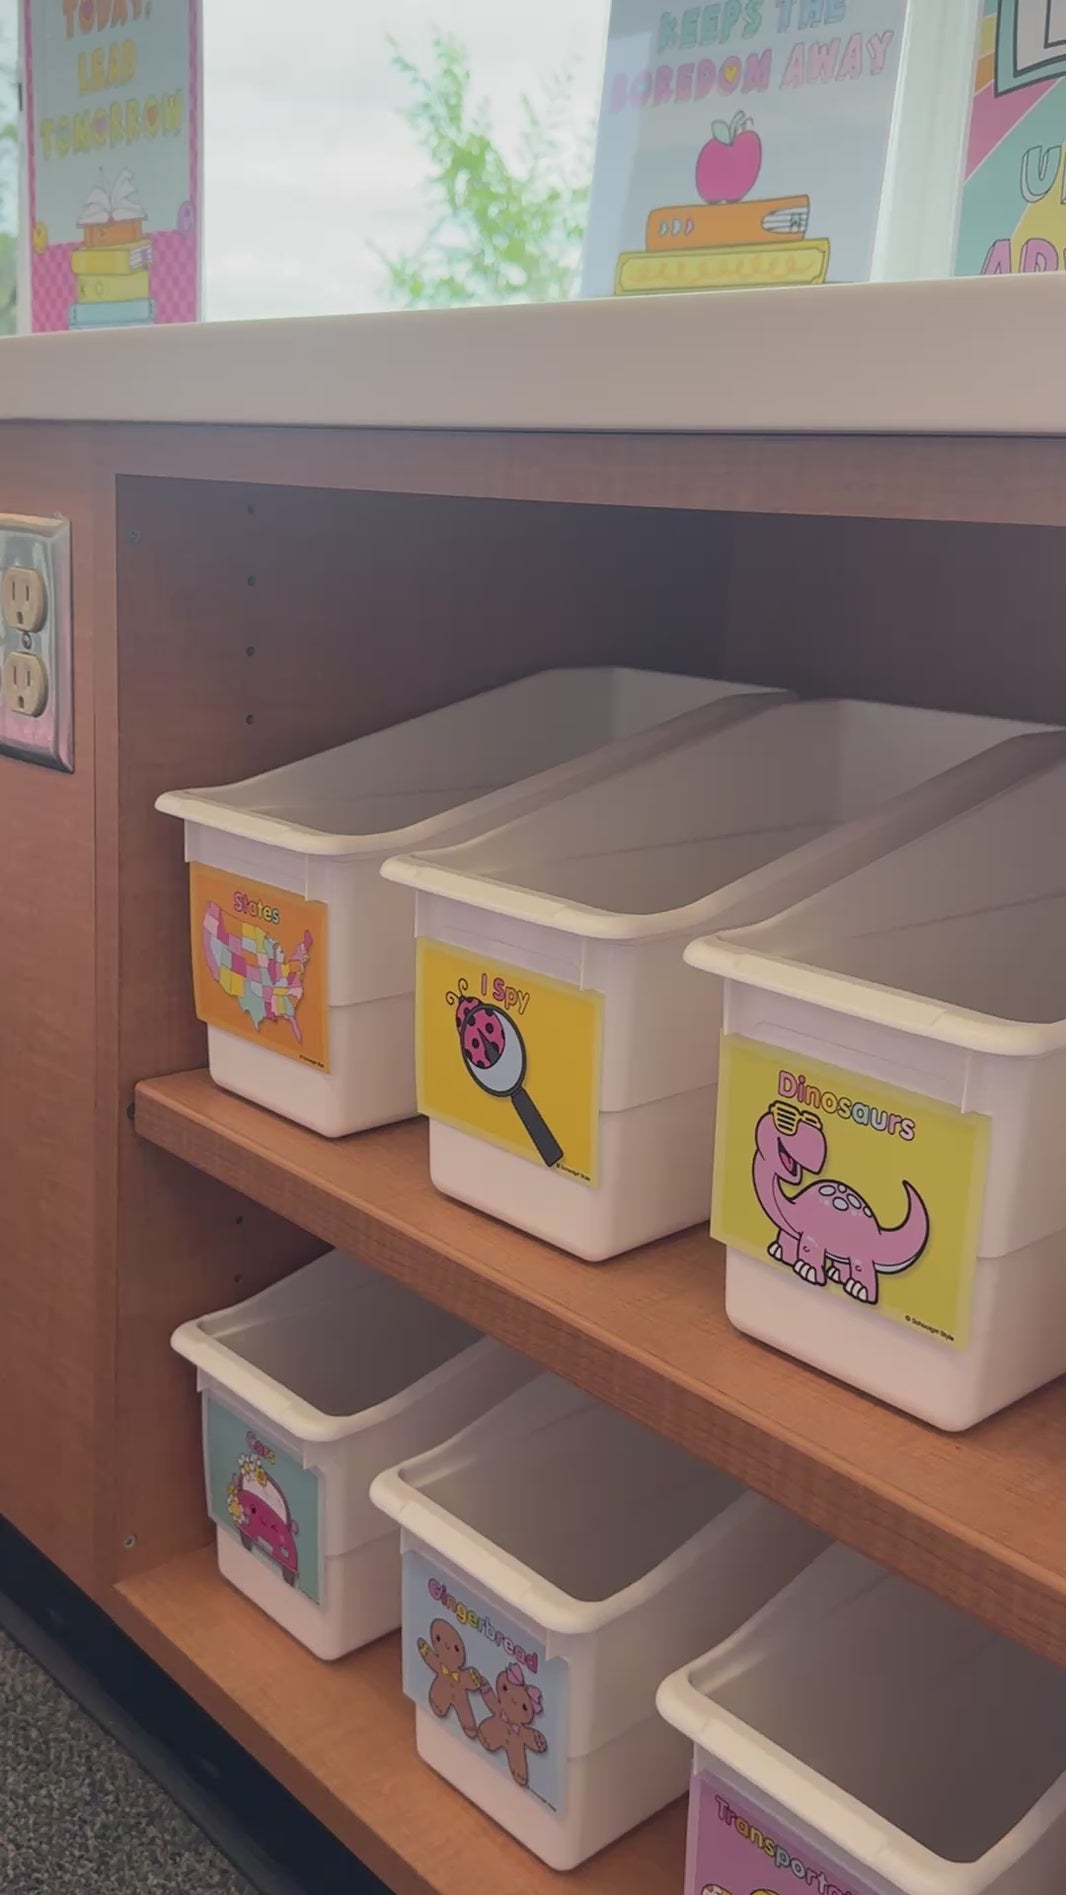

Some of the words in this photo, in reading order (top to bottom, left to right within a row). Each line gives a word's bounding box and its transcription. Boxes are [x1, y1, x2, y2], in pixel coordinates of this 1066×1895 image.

[657, 0, 762, 53] KEEPS
[775, 0, 846, 33] THE
[77, 39, 138, 96] LEAD
[610, 48, 773, 112] BOREDOM
[778, 30, 895, 90] AWAY
[40, 90, 184, 161] TOMORROW
[233, 891, 280, 925] States
[480, 973, 488, 996] I
[493, 977, 530, 1016] Spy
[778, 1070, 916, 1141] Dinosaurs
[427, 1577, 539, 1674] Gingerbread
